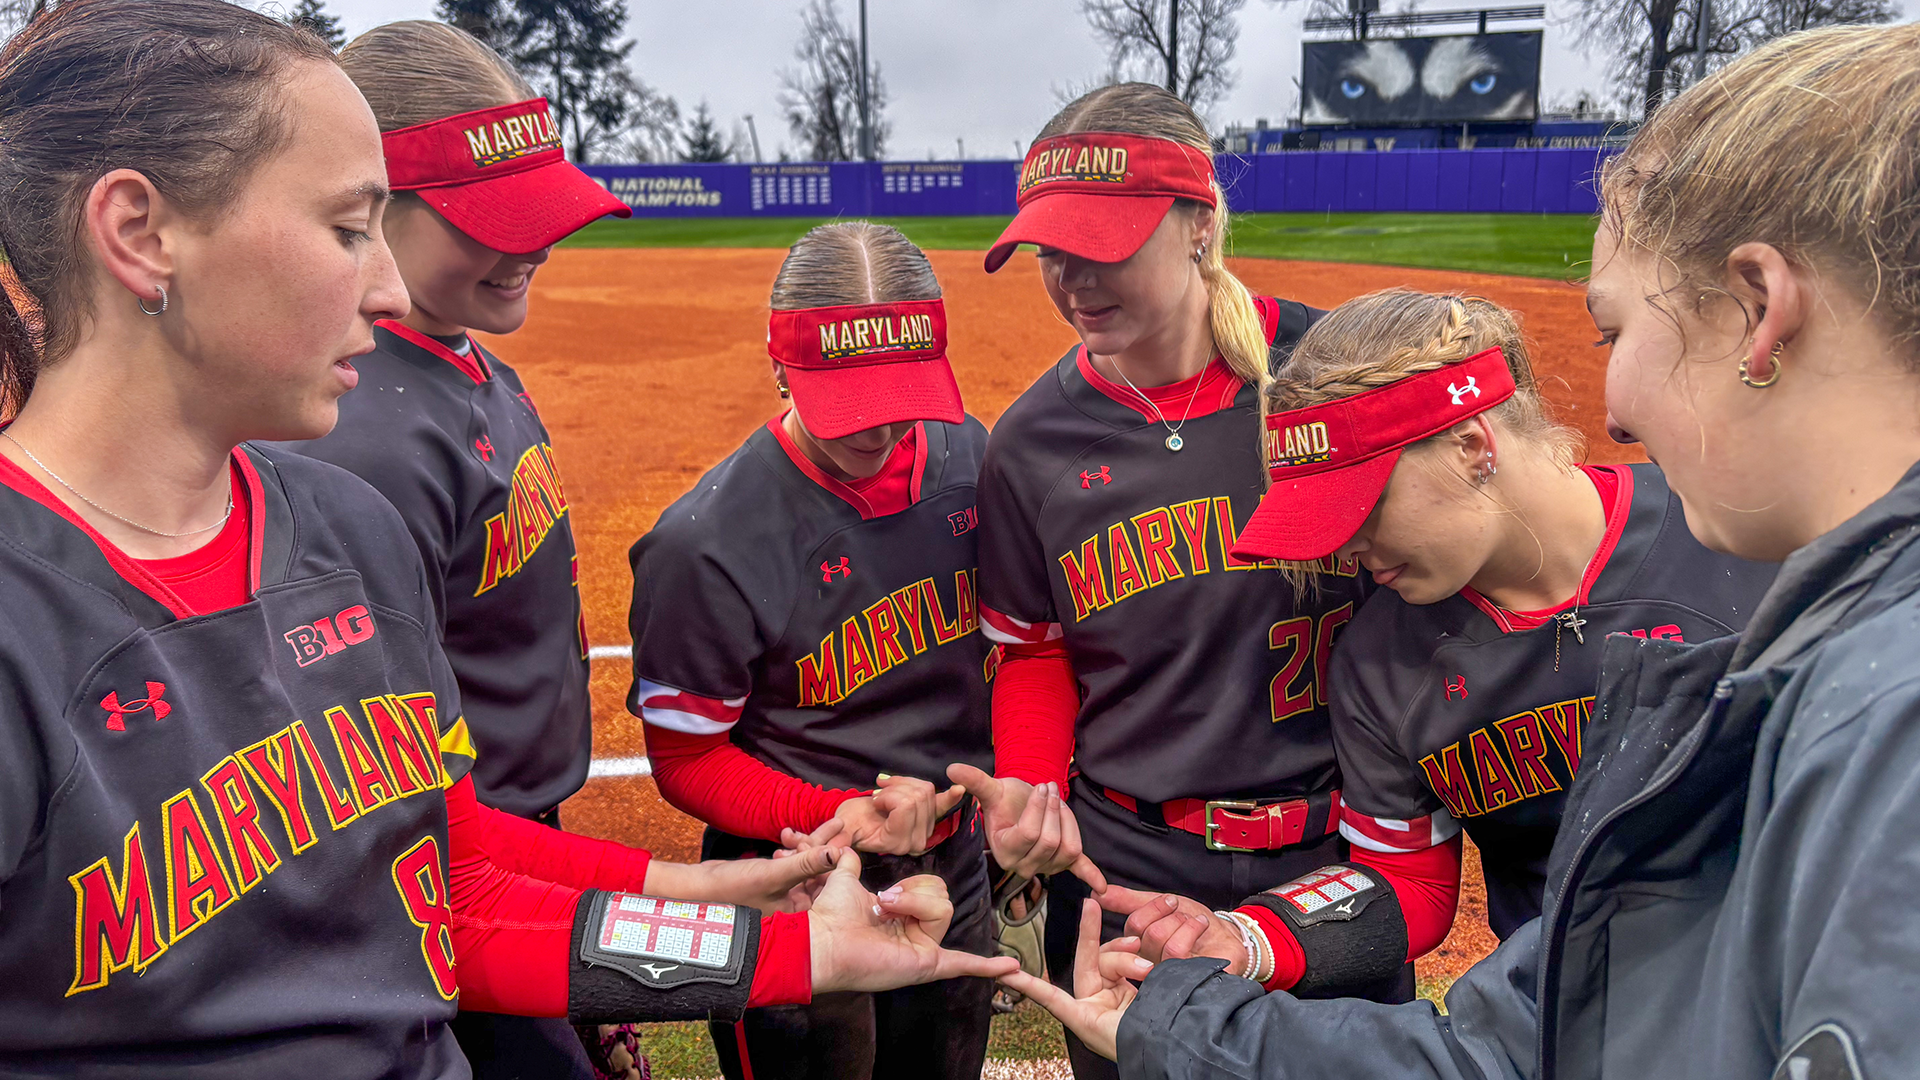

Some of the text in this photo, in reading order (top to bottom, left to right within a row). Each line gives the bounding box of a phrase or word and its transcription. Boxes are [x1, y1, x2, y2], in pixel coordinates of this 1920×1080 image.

[462, 111, 561, 161] MARYLA
[1019, 146, 1127, 190] MARYLAND
[611, 177, 704, 192] NATIONAL
[818, 314, 934, 353] MARYLAND
[1268, 421, 1331, 461] YLAND
[1058, 495, 1359, 623] MARYL
[795, 567, 981, 708] MARYLA
[1417, 695, 1597, 819] MARY
[65, 691, 446, 998] MARYLAND
[391, 835, 459, 1001] 8
